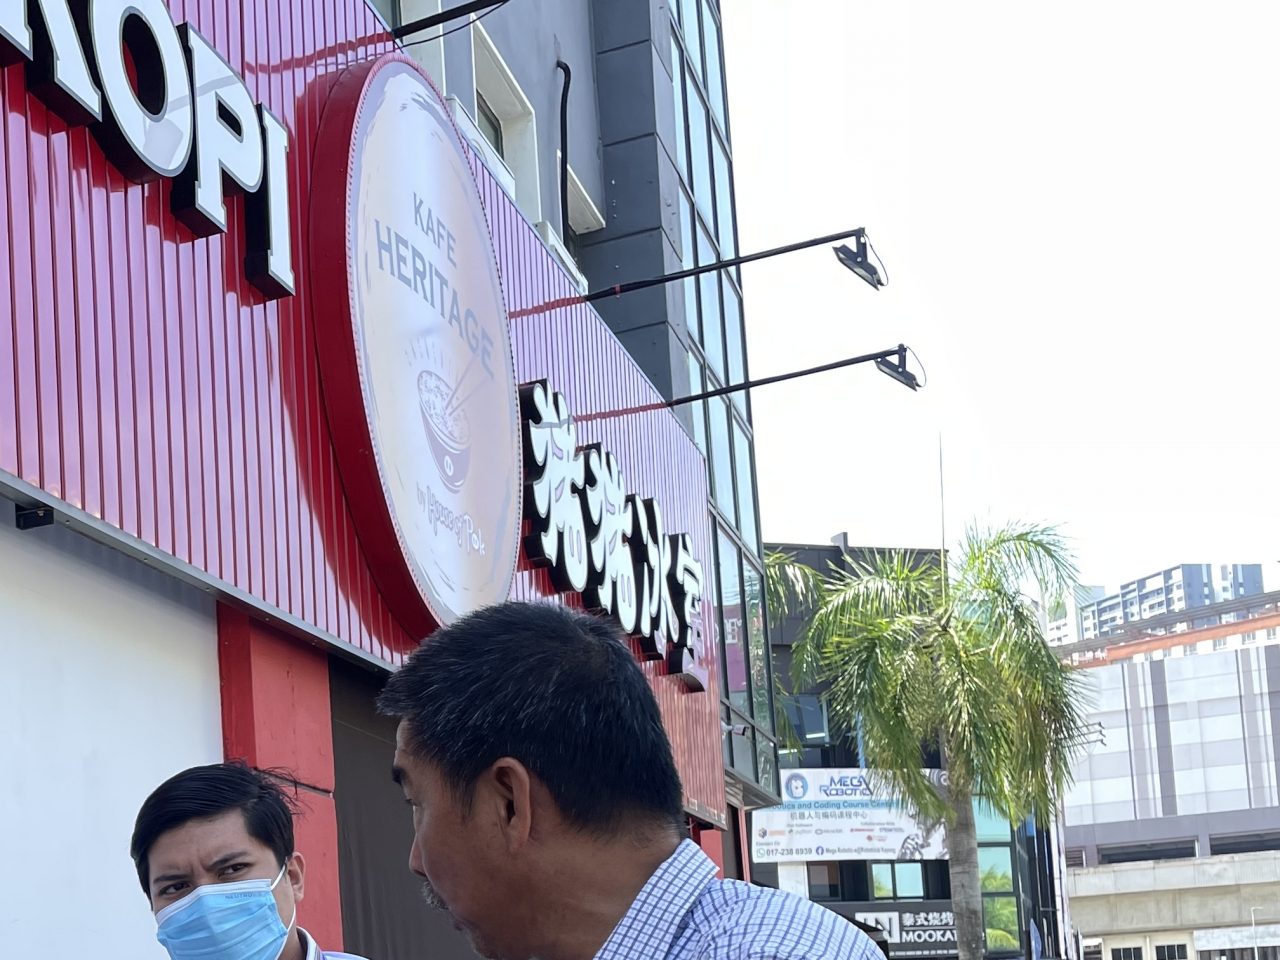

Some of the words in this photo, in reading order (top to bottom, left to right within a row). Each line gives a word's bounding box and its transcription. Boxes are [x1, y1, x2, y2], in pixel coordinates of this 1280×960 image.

[413, 192, 457, 269] KAFE
[375, 218, 495, 381] HERITAGE
[426, 485, 454, 537] House
[463, 512, 486, 555] Pok
[813, 801, 841, 810] Coding
[842, 800, 869, 808] Course
[830, 775, 871, 788] MEGA
